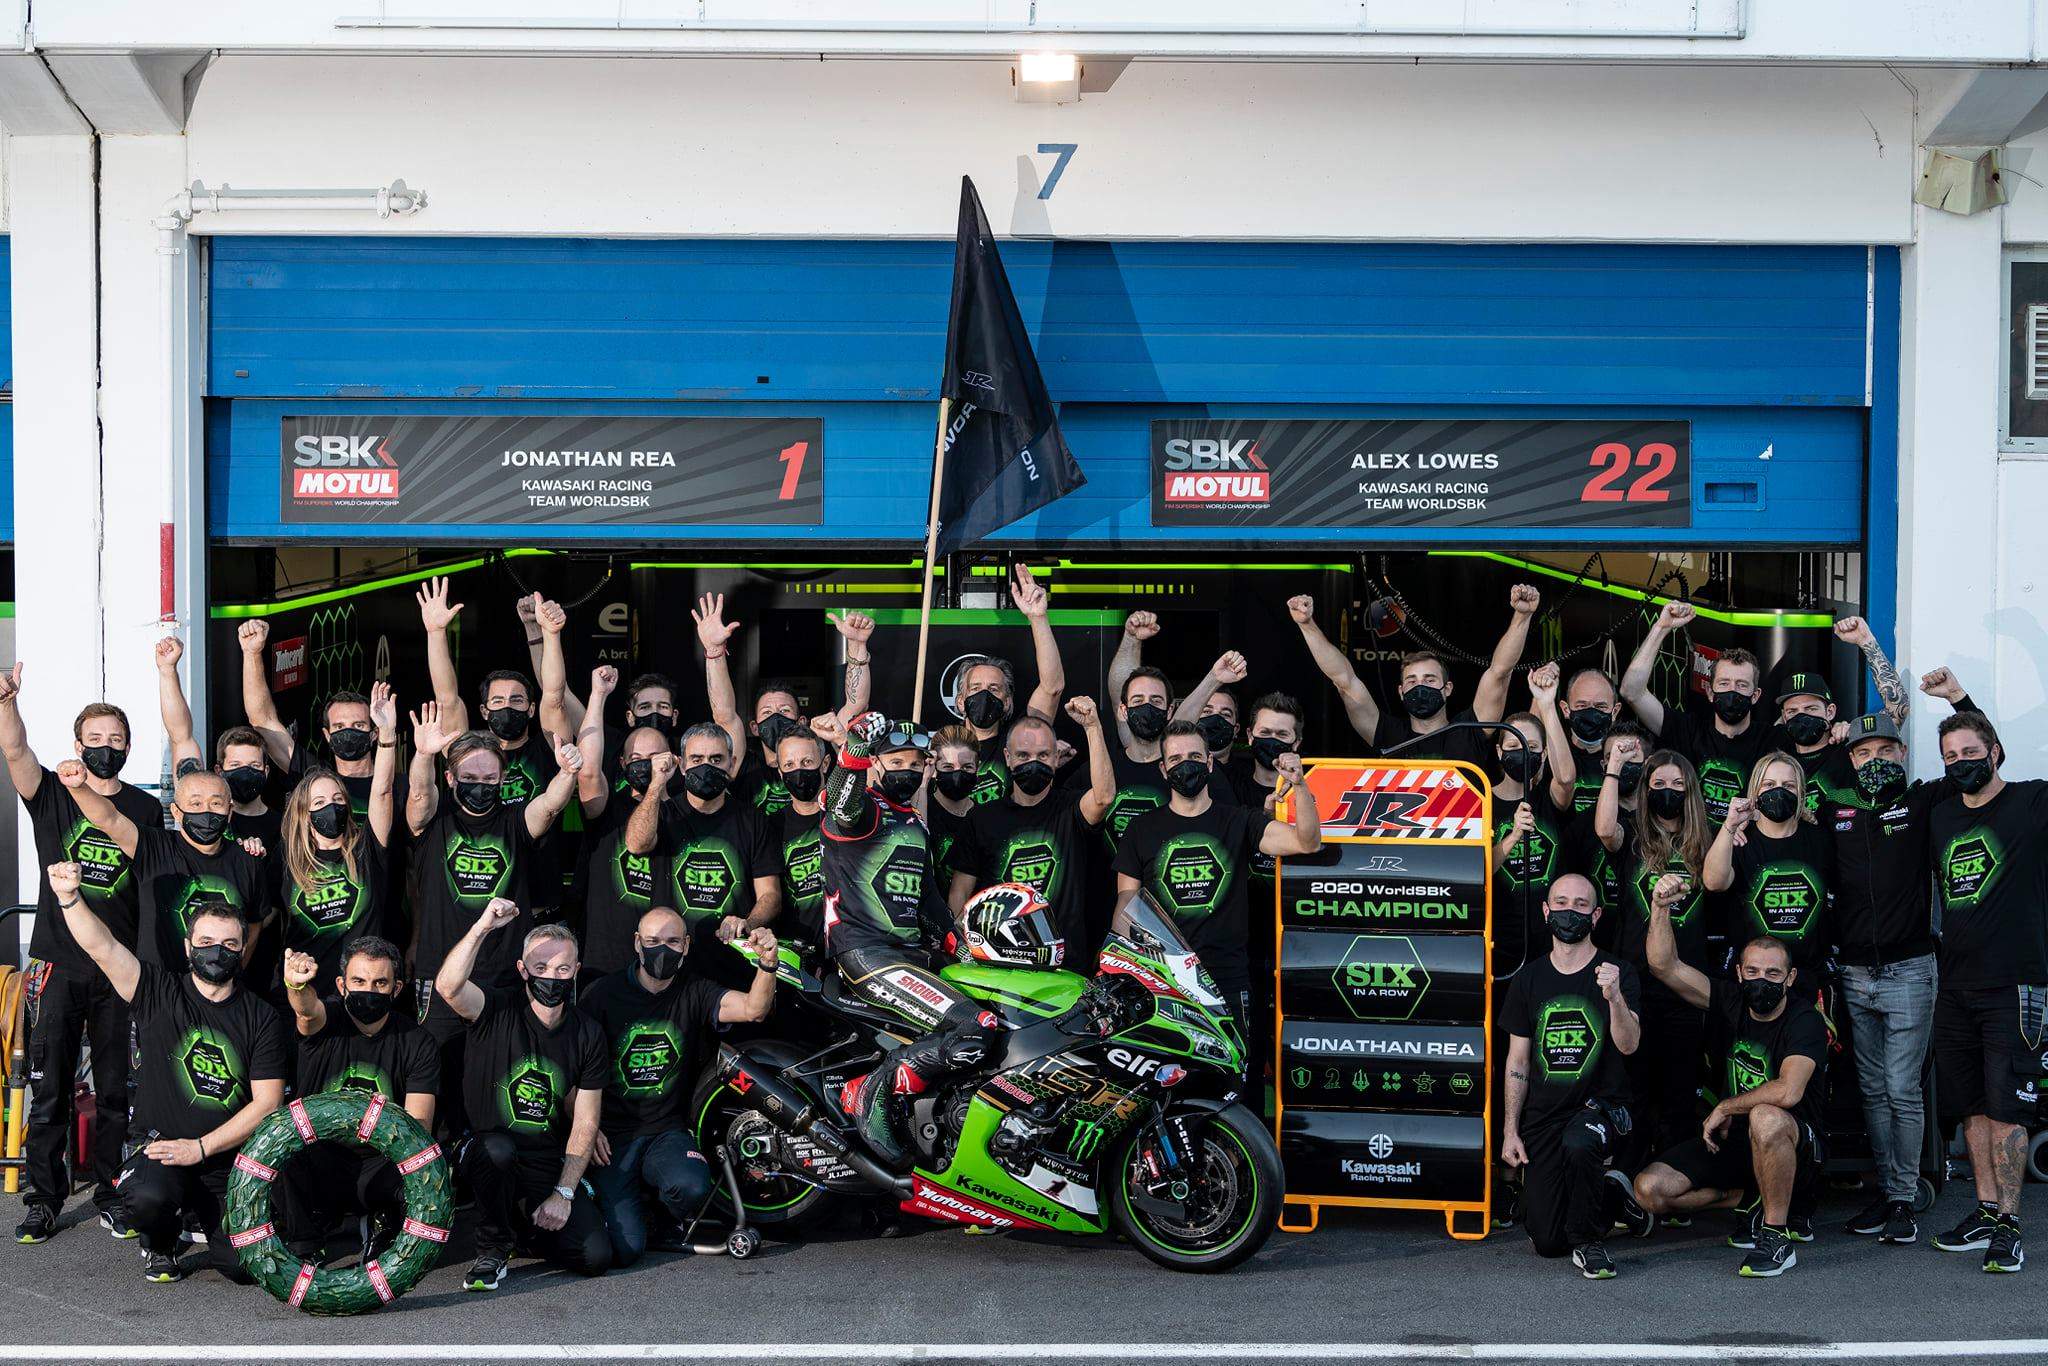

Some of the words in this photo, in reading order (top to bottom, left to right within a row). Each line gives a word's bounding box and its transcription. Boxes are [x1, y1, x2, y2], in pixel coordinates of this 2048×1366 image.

[1037, 144, 1078, 200] 7
[294, 436, 380, 467] SBK
[501, 451, 623, 468] JONATHAN
[630, 451, 676, 468] REA
[1164, 439, 1250, 470] SBK
[1351, 454, 1411, 469] ALEX
[1418, 454, 1499, 469] LOWES
[778, 442, 808, 499] 1
[1581, 443, 1677, 502] 22
[299, 473, 394, 494] MOTUL
[522, 480, 596, 491] KAWASAKI
[599, 480, 652, 491] RACING
[1170, 477, 1264, 497] MOTUL
[1358, 483, 1432, 494] KAWASAKI
[1435, 483, 1488, 494] RACING
[528, 496, 568, 507] TEAM
[571, 496, 650, 507] WORLDSBK
[1365, 498, 1404, 509] TEAM
[1407, 498, 1486, 509] WORLDSBK
[500, 780, 527, 800] IX
[1321, 791, 1430, 828] JR
[78, 844, 122, 866] SIX
[454, 856, 499, 874] SIX
[626, 855, 651, 874] SI
[96, 864, 115, 872] ROW
[685, 868, 725, 886] SIX
[1170, 864, 1215, 883] SIX
[1951, 856, 1986, 878] SIX
[305, 881, 350, 907] SIX
[1311, 882, 1363, 895] 2020
[1367, 884, 1451, 896] WorldSBK
[1764, 890, 1809, 907] SIX
[311, 904, 320, 912] IN
[328, 899, 347, 908] ROW
[1295, 900, 1468, 920] CHAMPION
[1002, 948, 1037, 958] MONSTER
[1346, 962, 1416, 988] SIX
[897, 975, 944, 1006] SHOWA
[867, 982, 940, 1026] alpinestars
[1290, 1038, 1422, 1055] JONATHAN
[1428, 1043, 1475, 1056] REA
[1546, 1030, 1587, 1048] SIX
[192, 1054, 231, 1079] SIX
[629, 1049, 670, 1068] SIX
[1107, 1048, 1161, 1077] elf
[991, 1075, 1035, 1105] SHOWA
[1297, 1068, 1306, 1086] 1
[1418, 1075, 1431, 1092] 5
[1452, 1078, 1470, 1086] SIX
[1174, 1117, 1194, 1163] PIRELLI
[1041, 1156, 1090, 1181] MONSTER
[1342, 1160, 1421, 1176] Kawasaki
[1351, 1174, 1384, 1184] Racing
[1386, 1175, 1412, 1183] Team
[955, 1174, 1061, 1222] Kawasaki
[940, 1209, 959, 1221] PASSION
